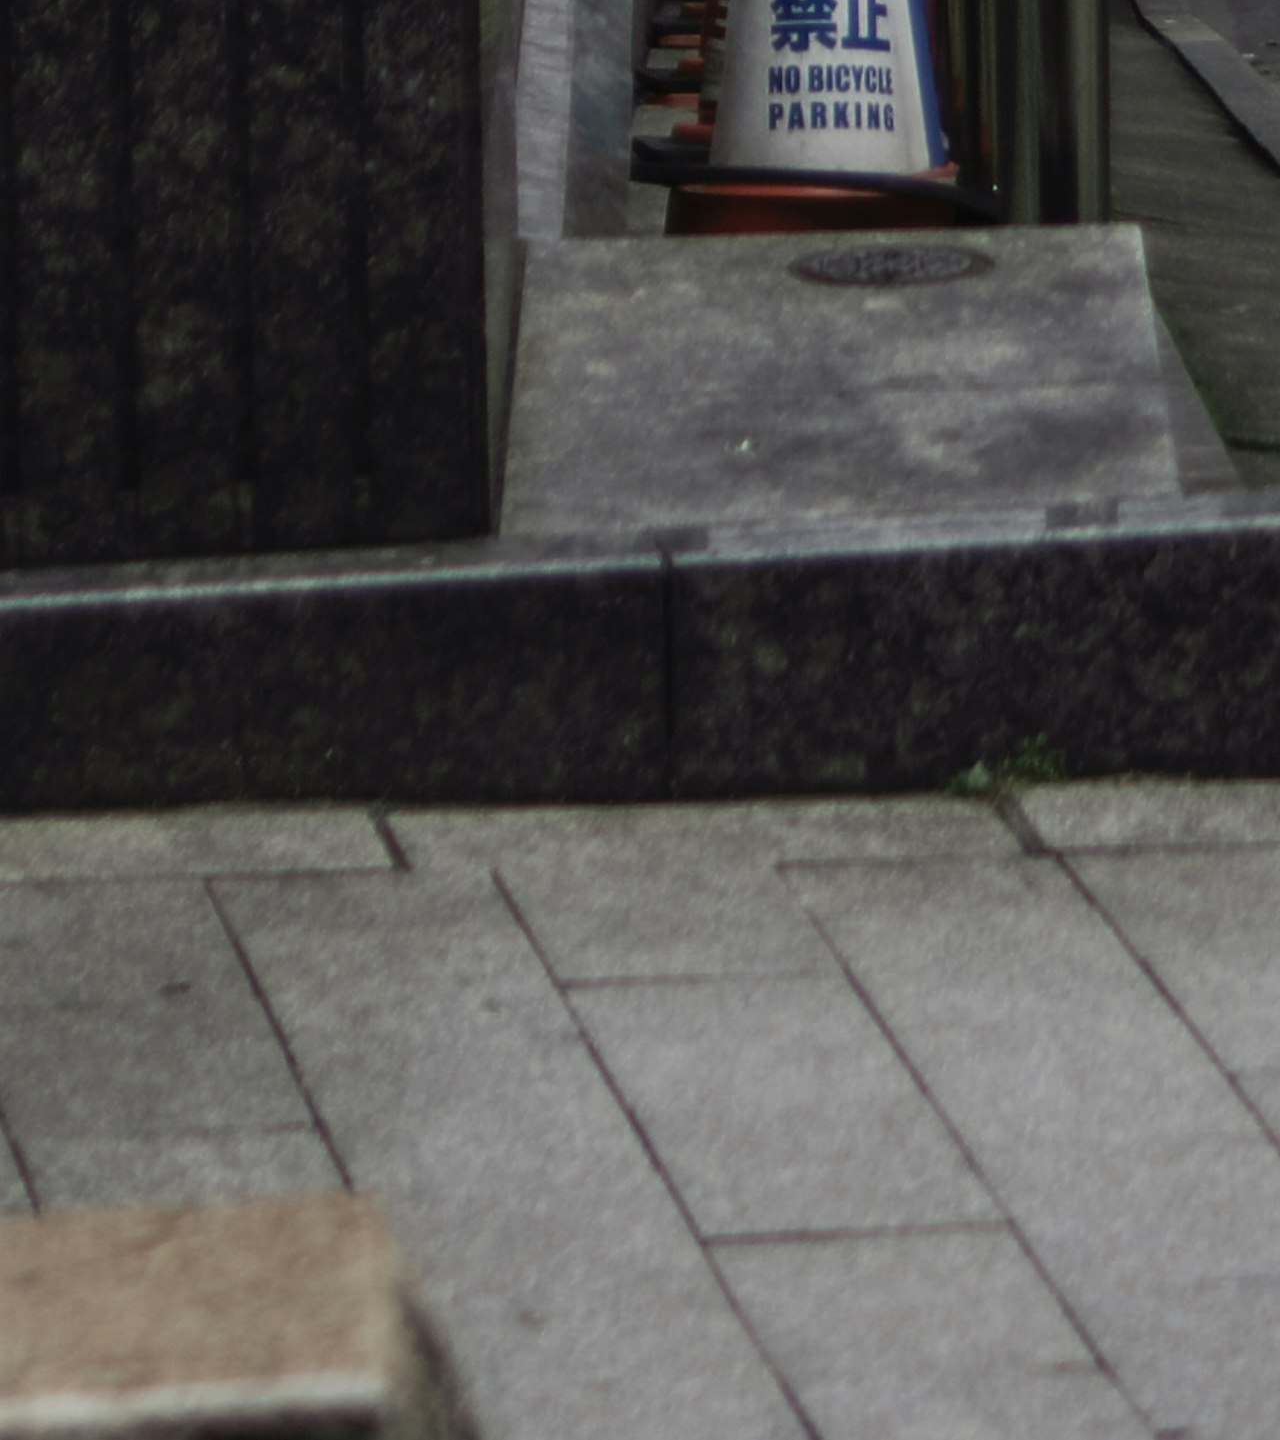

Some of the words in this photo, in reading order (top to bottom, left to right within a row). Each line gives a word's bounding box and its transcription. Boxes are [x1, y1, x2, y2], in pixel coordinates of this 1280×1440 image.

[768, 65, 801, 96] NO
[808, 64, 893, 96] BICYCLE
[768, 100, 895, 132] PARKING
